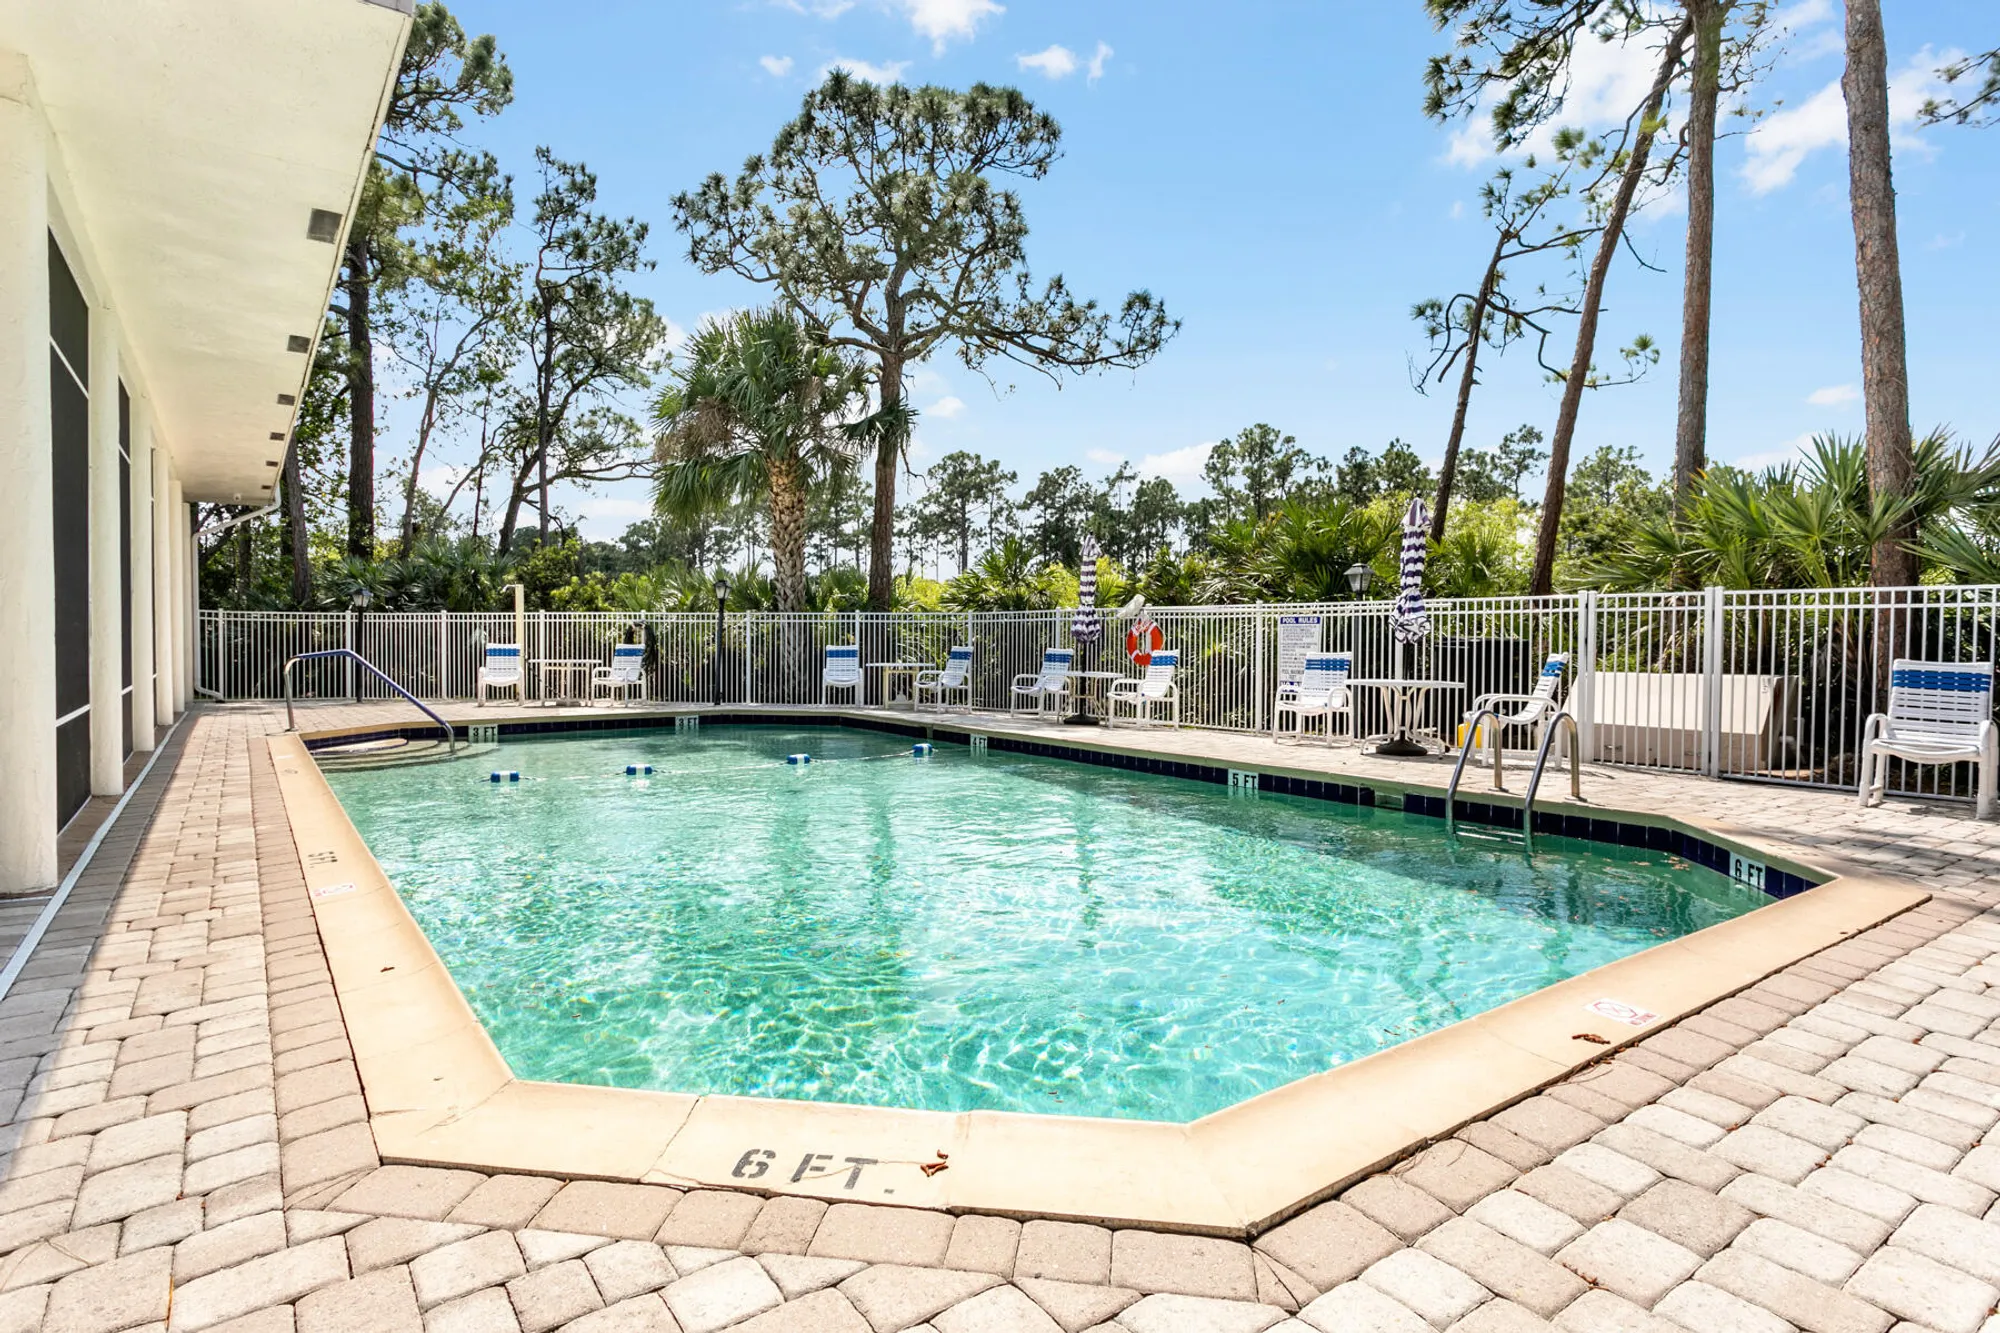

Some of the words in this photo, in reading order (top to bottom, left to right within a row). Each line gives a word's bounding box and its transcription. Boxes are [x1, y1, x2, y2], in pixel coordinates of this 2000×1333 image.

[679, 718, 684, 727] 3
[473, 727, 479, 737] 3
[1233, 773, 1239, 786] 5
[1735, 859, 1742, 880] 6
[731, 1148, 776, 1179] 6
